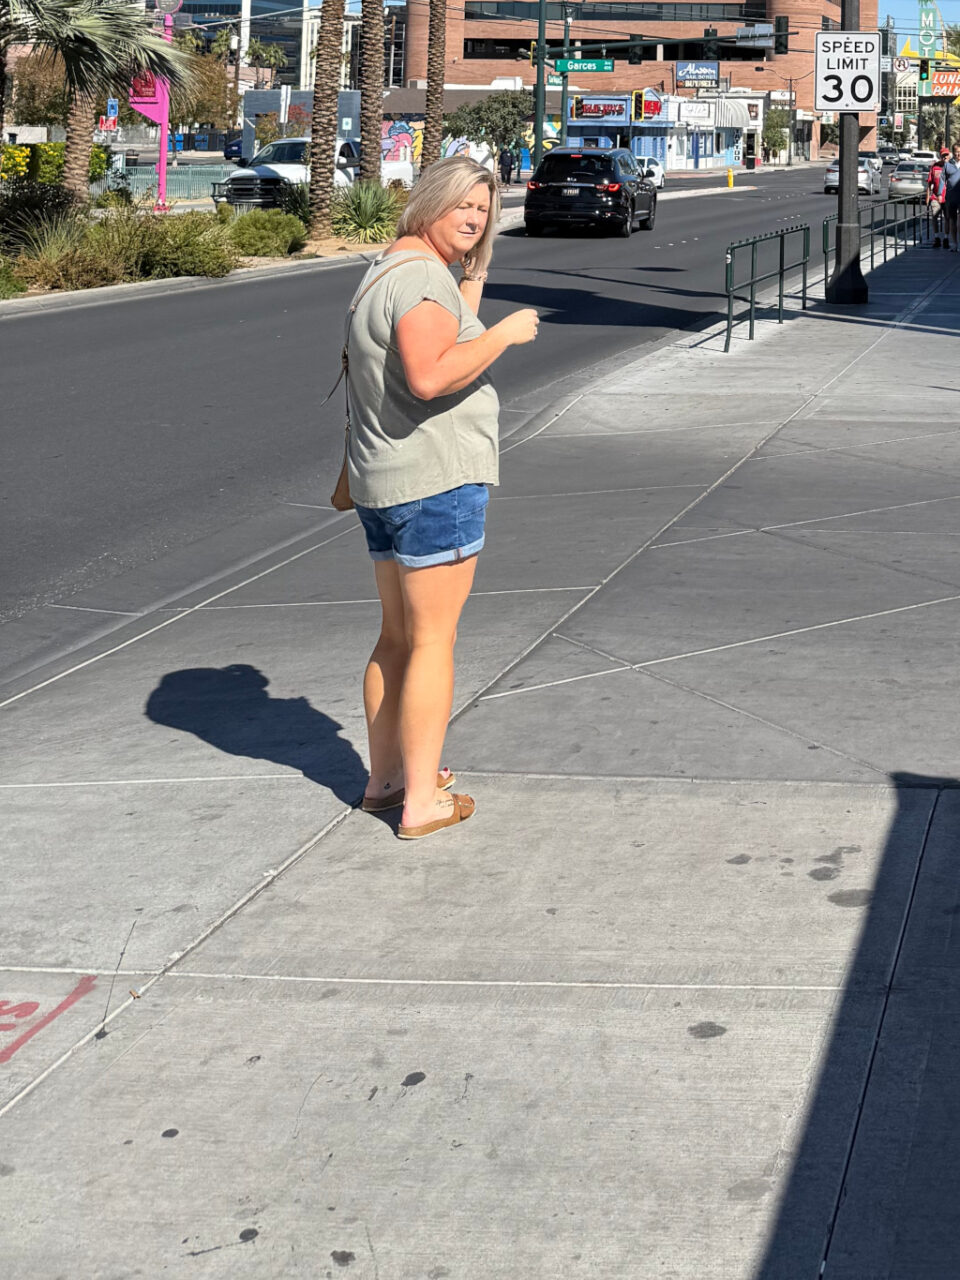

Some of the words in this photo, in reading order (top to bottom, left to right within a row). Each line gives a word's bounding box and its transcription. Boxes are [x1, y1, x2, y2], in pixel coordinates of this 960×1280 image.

[821, 40, 876, 55] SPEED
[919, 12, 935, 97] MOTL
[567, 61, 597, 70] Garces
[826, 57, 869, 72] LIMIT
[822, 74, 875, 104] 30
